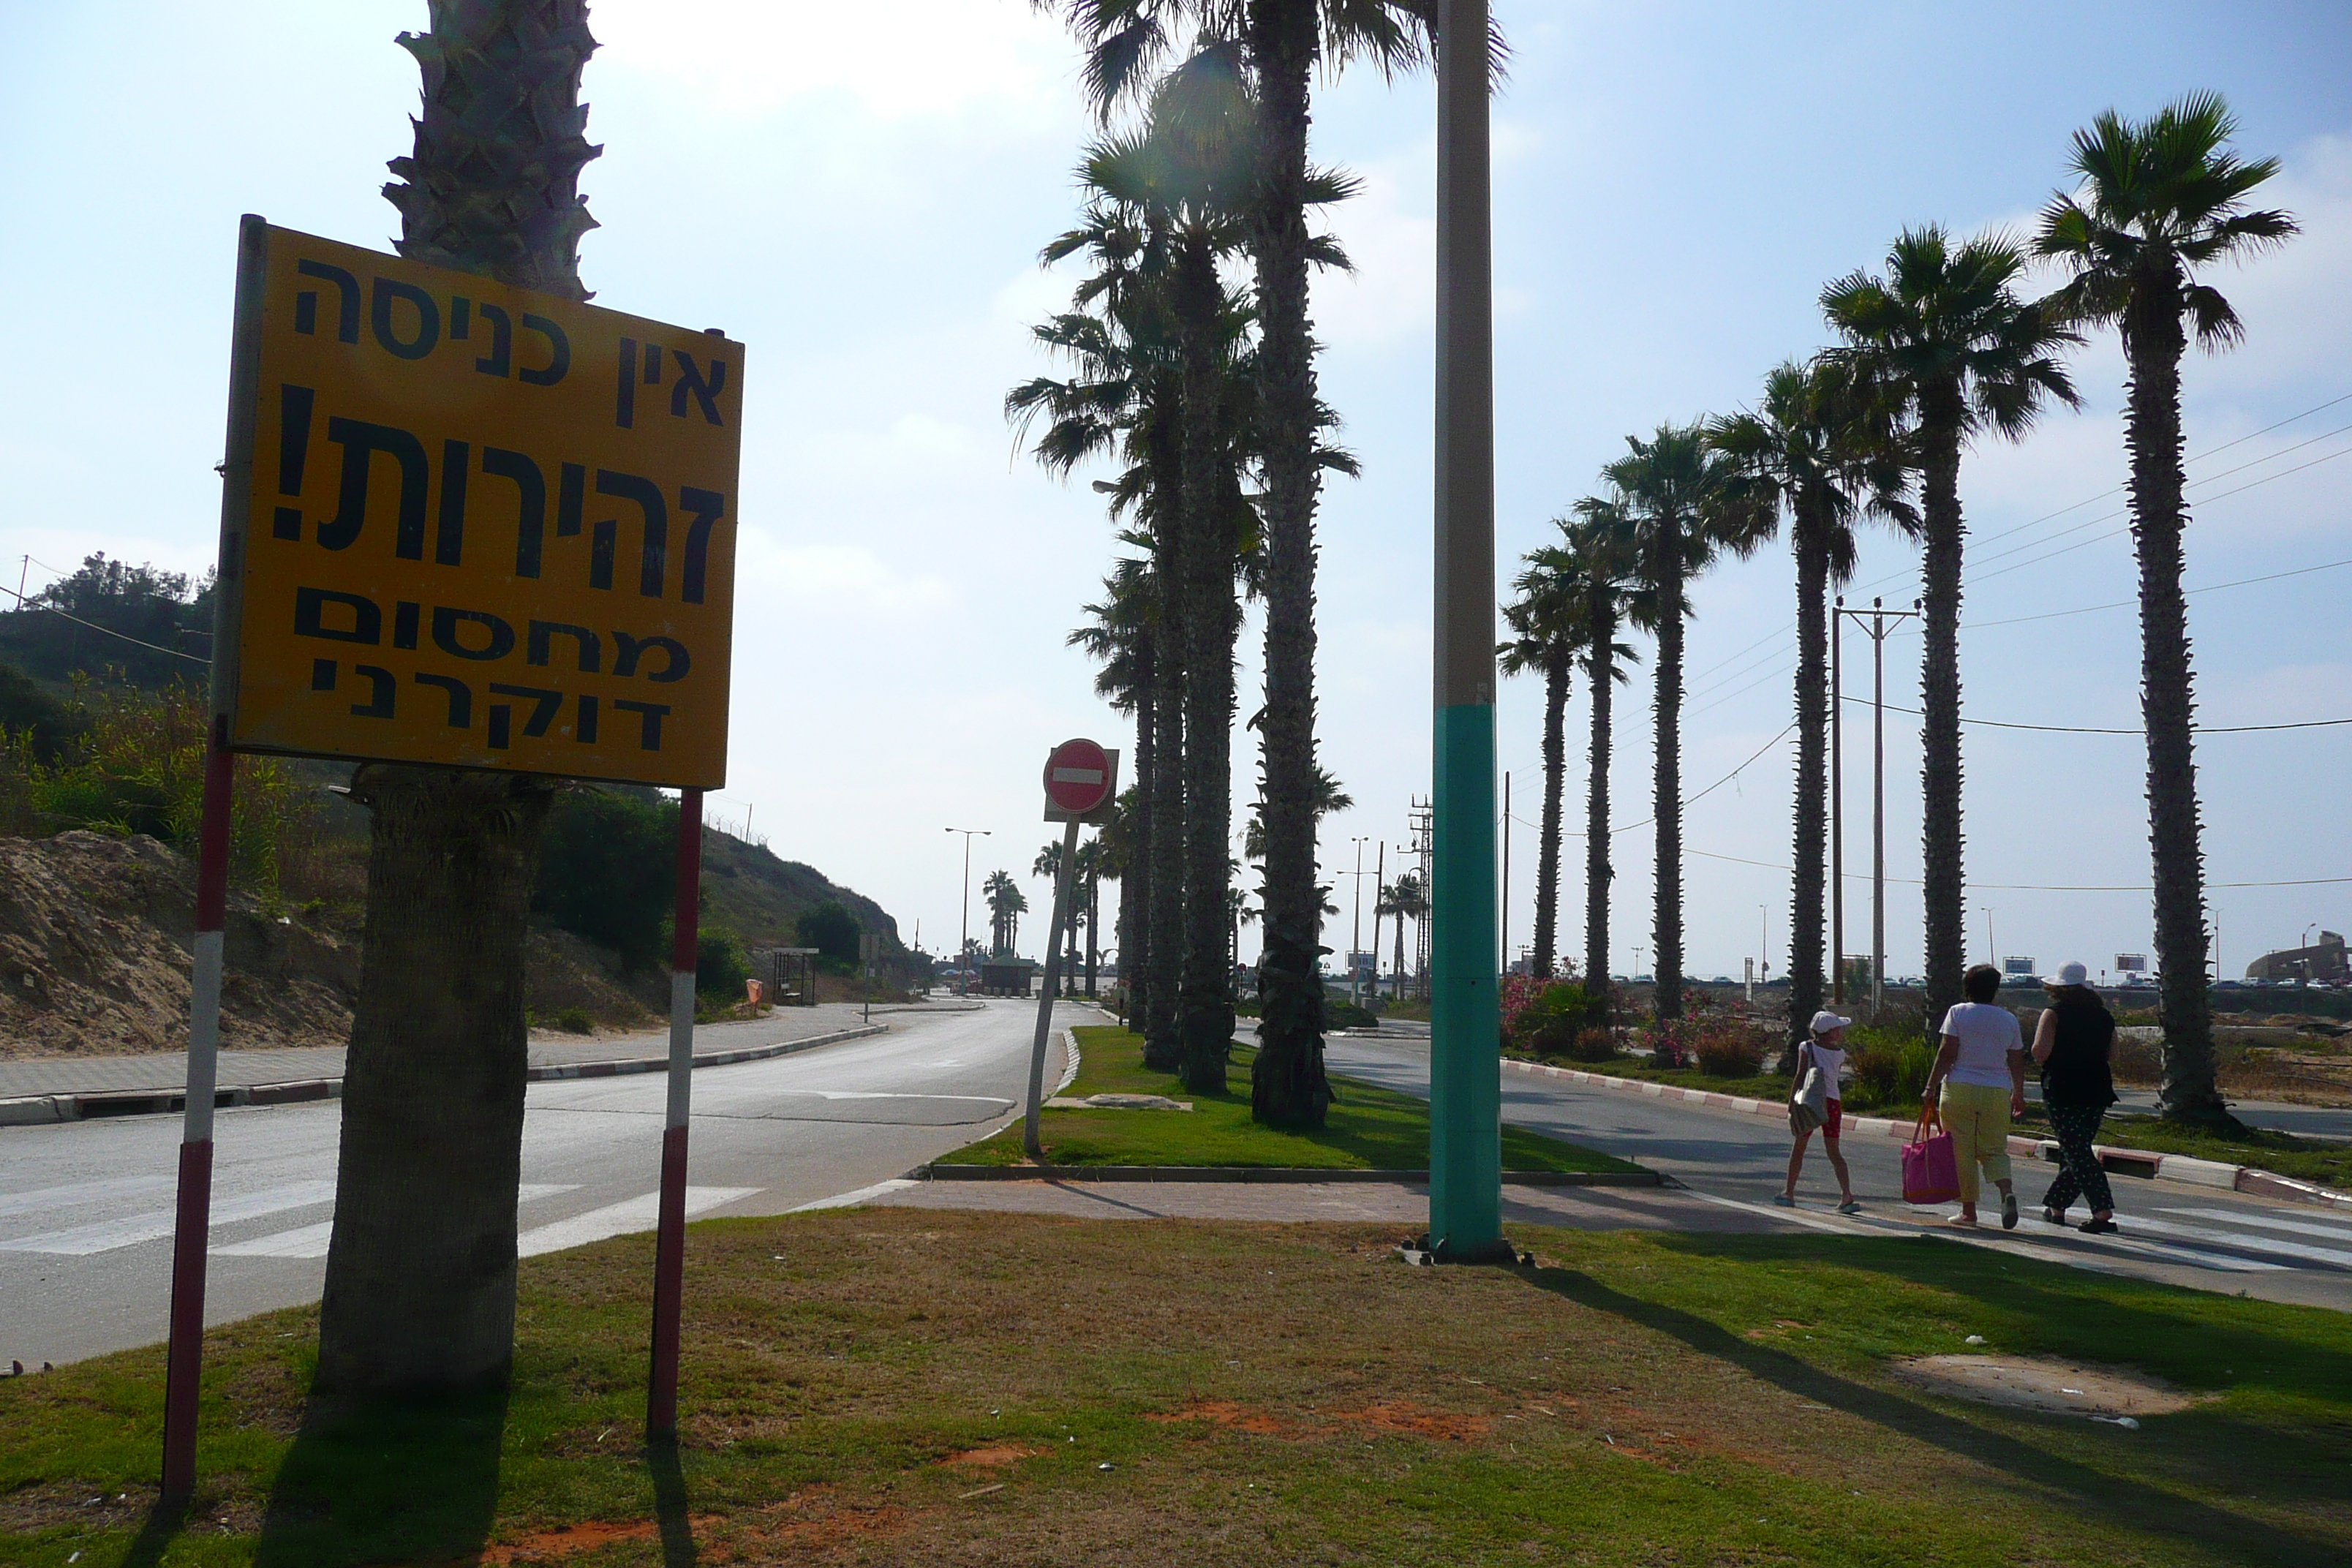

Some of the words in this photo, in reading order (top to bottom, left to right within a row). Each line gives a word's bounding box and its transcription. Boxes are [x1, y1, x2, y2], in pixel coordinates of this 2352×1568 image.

[294, 257, 571, 387] כניסה
[615, 336, 726, 429] אין
[273, 383, 725, 605] זהירות!
[293, 586, 692, 683] מחסום
[311, 657, 671, 752] דוקרני
